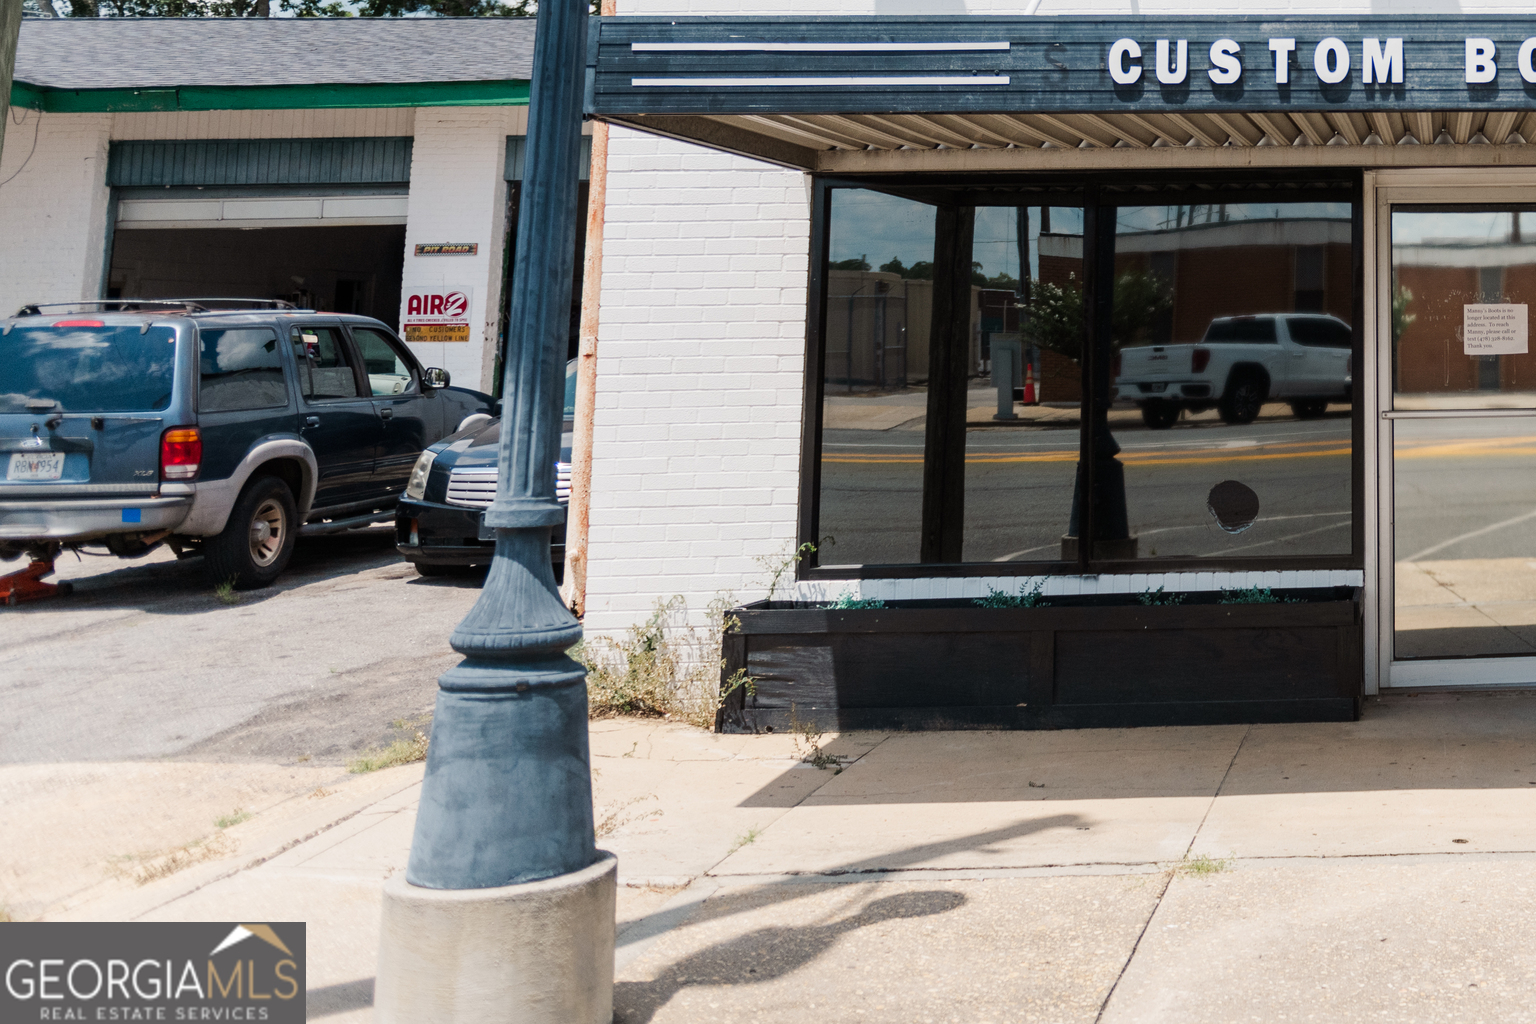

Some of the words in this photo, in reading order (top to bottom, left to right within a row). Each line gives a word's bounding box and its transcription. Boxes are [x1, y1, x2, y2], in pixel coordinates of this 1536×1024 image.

[1108, 37, 1404, 85] CUSTOM
[423, 246, 440, 254] PIT
[441, 246, 469, 254] ROAD
[408, 294, 445, 315] AIR
